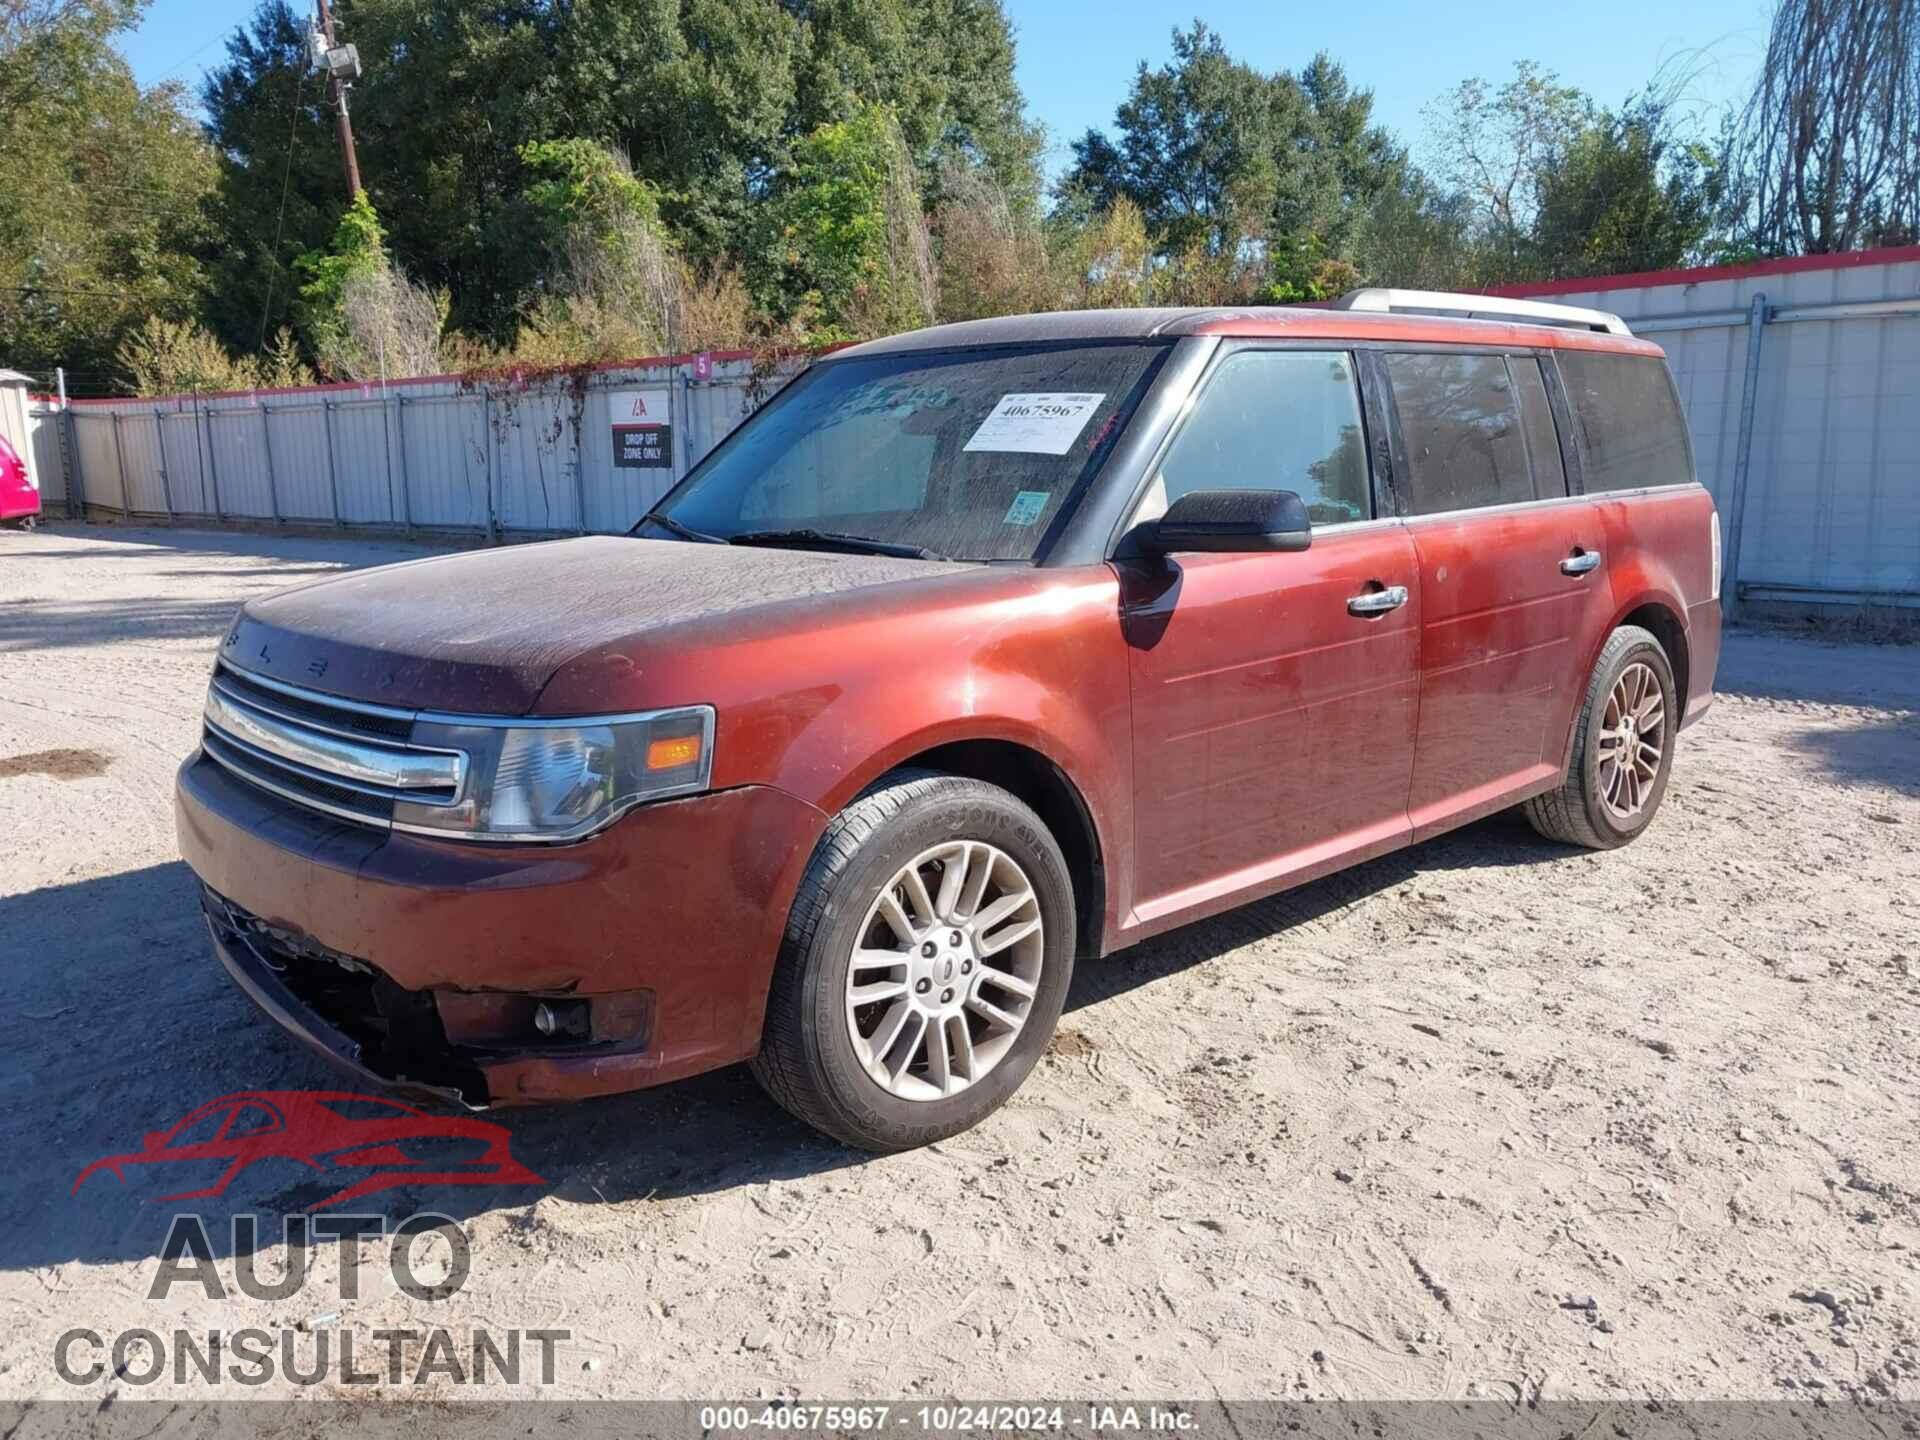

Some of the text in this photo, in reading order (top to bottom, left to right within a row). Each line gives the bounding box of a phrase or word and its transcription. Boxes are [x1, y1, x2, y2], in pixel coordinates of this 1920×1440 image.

[1001, 405, 1084, 417] 40675967
[624, 433, 658, 446] DROP OFF
[623, 447, 662, 460] ZONE ONLY
